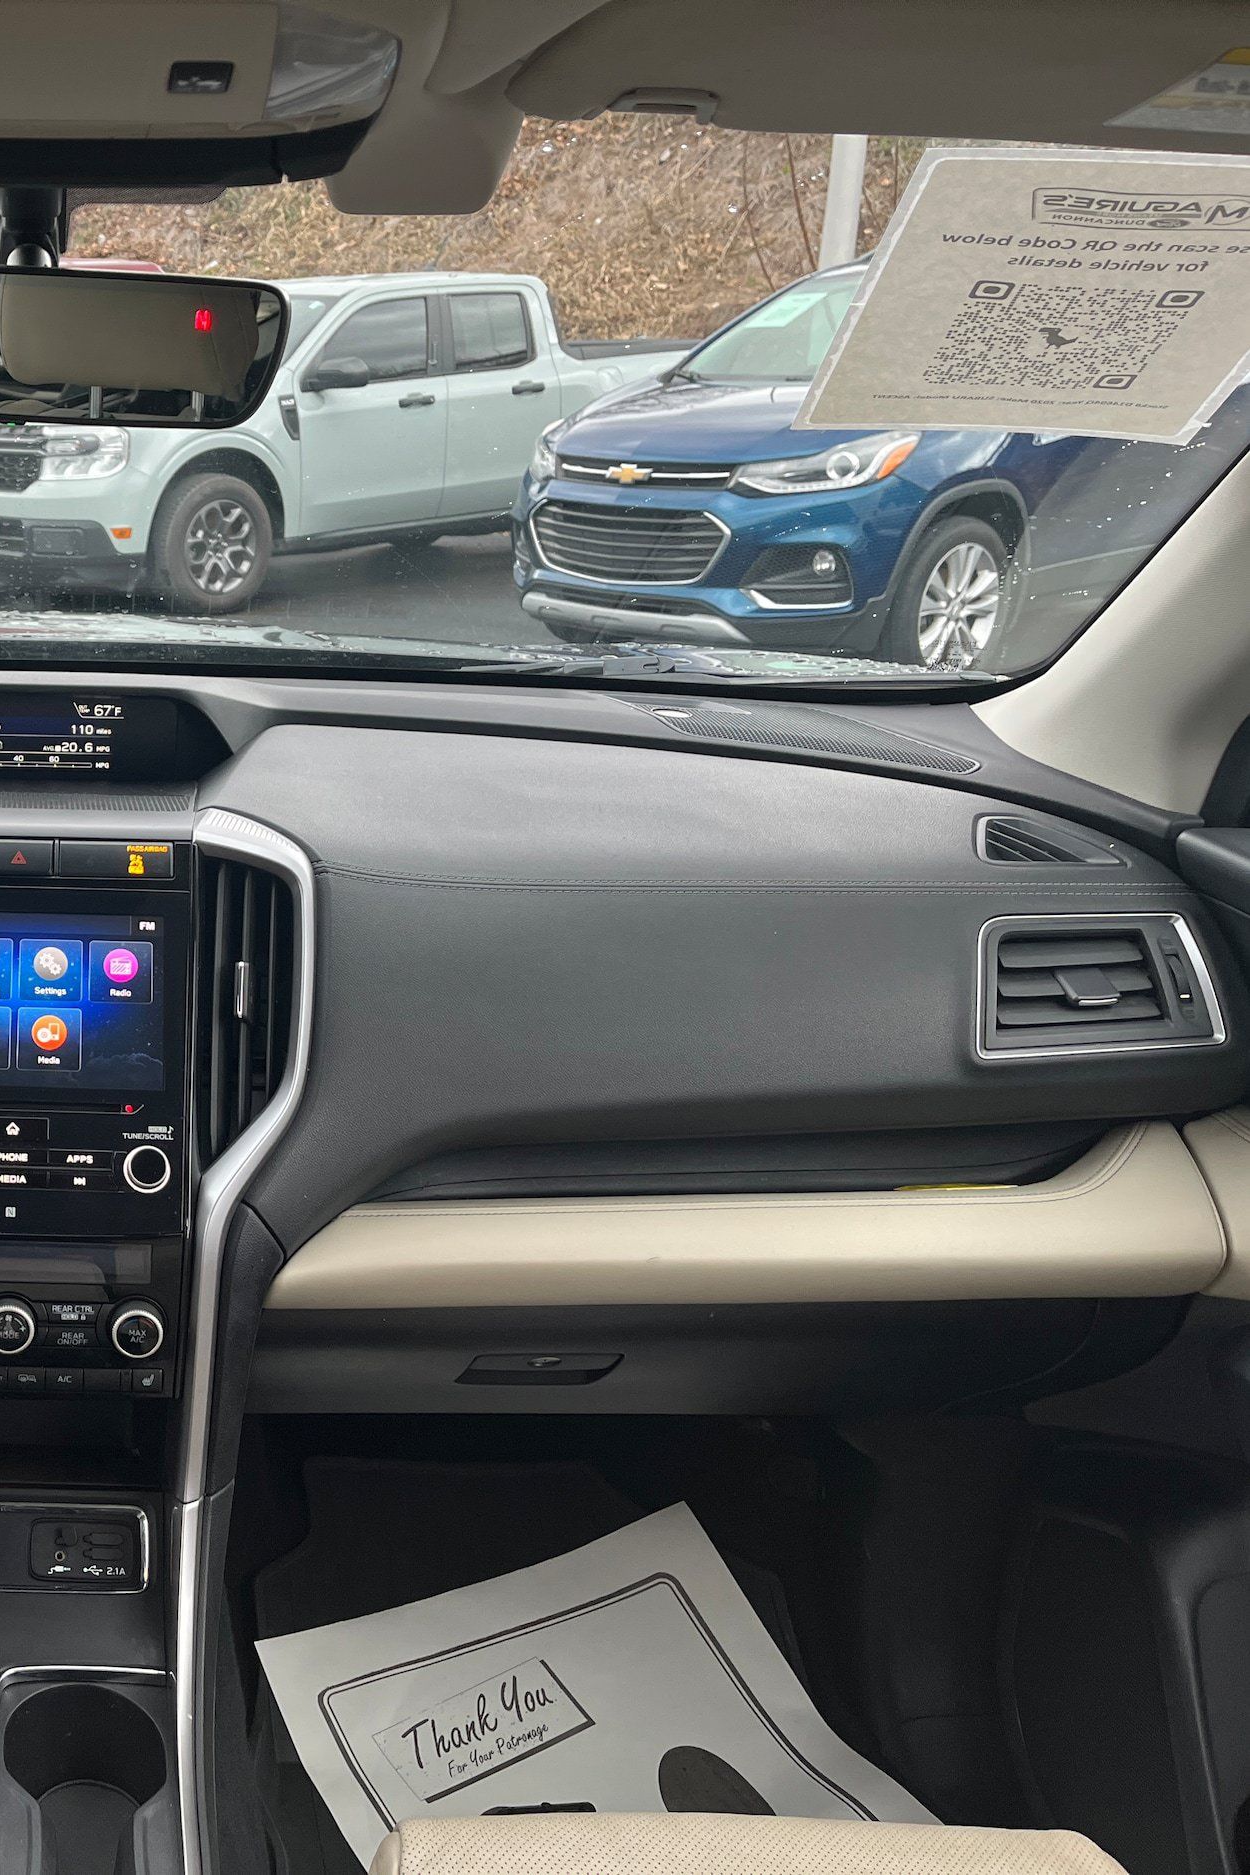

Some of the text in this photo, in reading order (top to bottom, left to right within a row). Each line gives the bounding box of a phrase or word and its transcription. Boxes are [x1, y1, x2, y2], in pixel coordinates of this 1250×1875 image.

[71, 724, 94, 735] 110
[61, 742, 94, 753] 20.6
[95, 745, 111, 753] MPG
[13, 754, 25, 762] 40
[139, 921, 155, 931] FM
[34, 986, 67, 996] Settings
[109, 988, 132, 998] Radio
[37, 1056, 60, 1065] Media
[122, 1132, 174, 1140] TUNE/SCROLL
[66, 1154, 94, 1165] APPS
[51, 1304, 95, 1313] REAR CTRL
[128, 1329, 147, 1337] MAX
[57, 1338, 88, 1346] ON/OFF
[129, 1336, 145, 1344] A/C
[57, 1375, 72, 1384] A/C
[106, 1567, 126, 1576] 2.1A
[401, 1675, 554, 1769] Thank You
[447, 1724, 549, 1778] For Your Patronage
